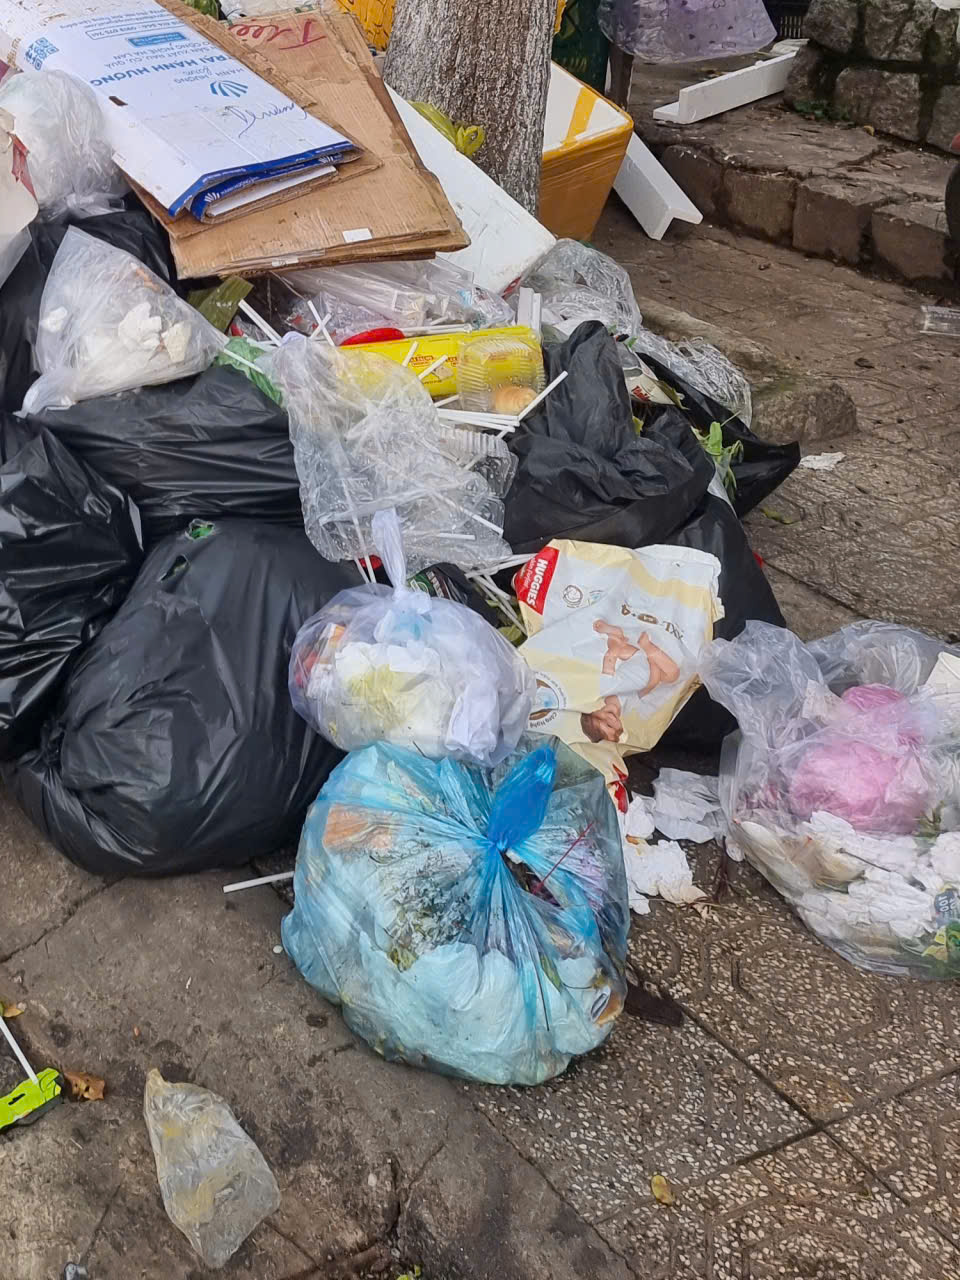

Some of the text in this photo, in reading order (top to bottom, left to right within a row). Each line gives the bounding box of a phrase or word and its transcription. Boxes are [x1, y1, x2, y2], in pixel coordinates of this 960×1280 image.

[90, 54, 232, 87] RẠI HẠNH HƯƠNG
[527, 558, 549, 606] HUGGIES
